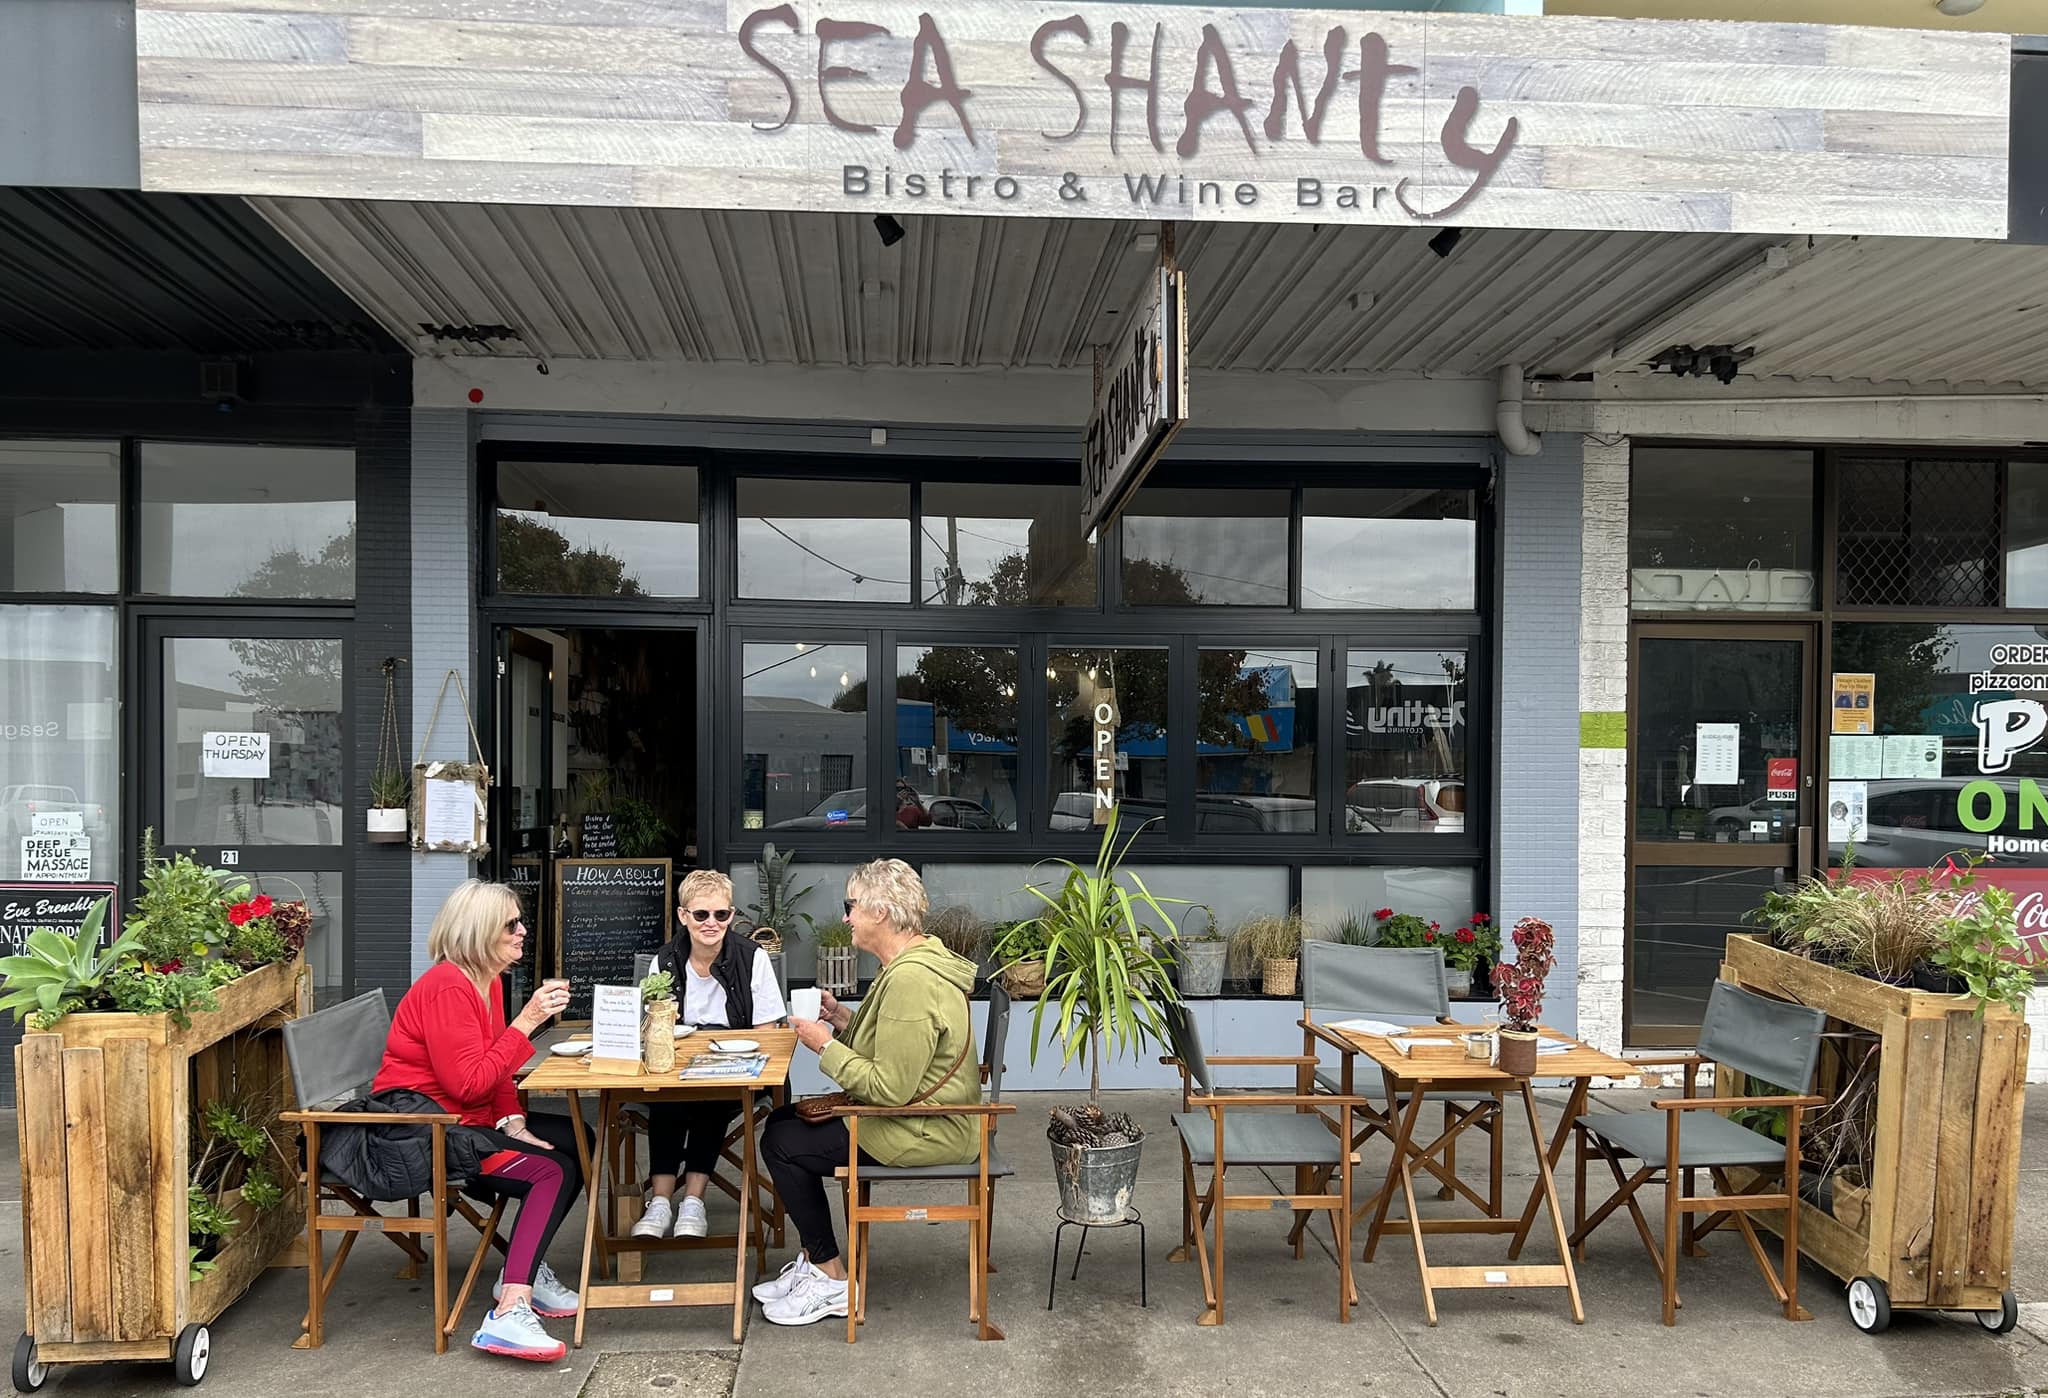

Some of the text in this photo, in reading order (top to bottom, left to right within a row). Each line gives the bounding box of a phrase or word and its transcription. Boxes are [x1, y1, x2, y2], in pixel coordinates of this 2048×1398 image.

[738, 4, 977, 150] SEA
[843, 165, 1387, 209] Bistro & Wine Bar
[1087, 404, 1108, 516] SEA
[1969, 670, 2048, 694] pizzaon
[215, 734, 261, 747] OPEN
[204, 749, 266, 760] THURSDAY
[1094, 703, 1113, 809] OPEN
[1768, 791, 1795, 799] PUSH
[40, 817, 68, 826] OPEN
[27, 840, 61, 849] DEEP
[25, 848, 71, 858] TISSUE
[223, 852, 238, 864] 21
[27, 858, 89, 871] MASSAGE
[576, 867, 660, 880] HOW ABOUT
[3, 896, 96, 920] Eve Brenchle
